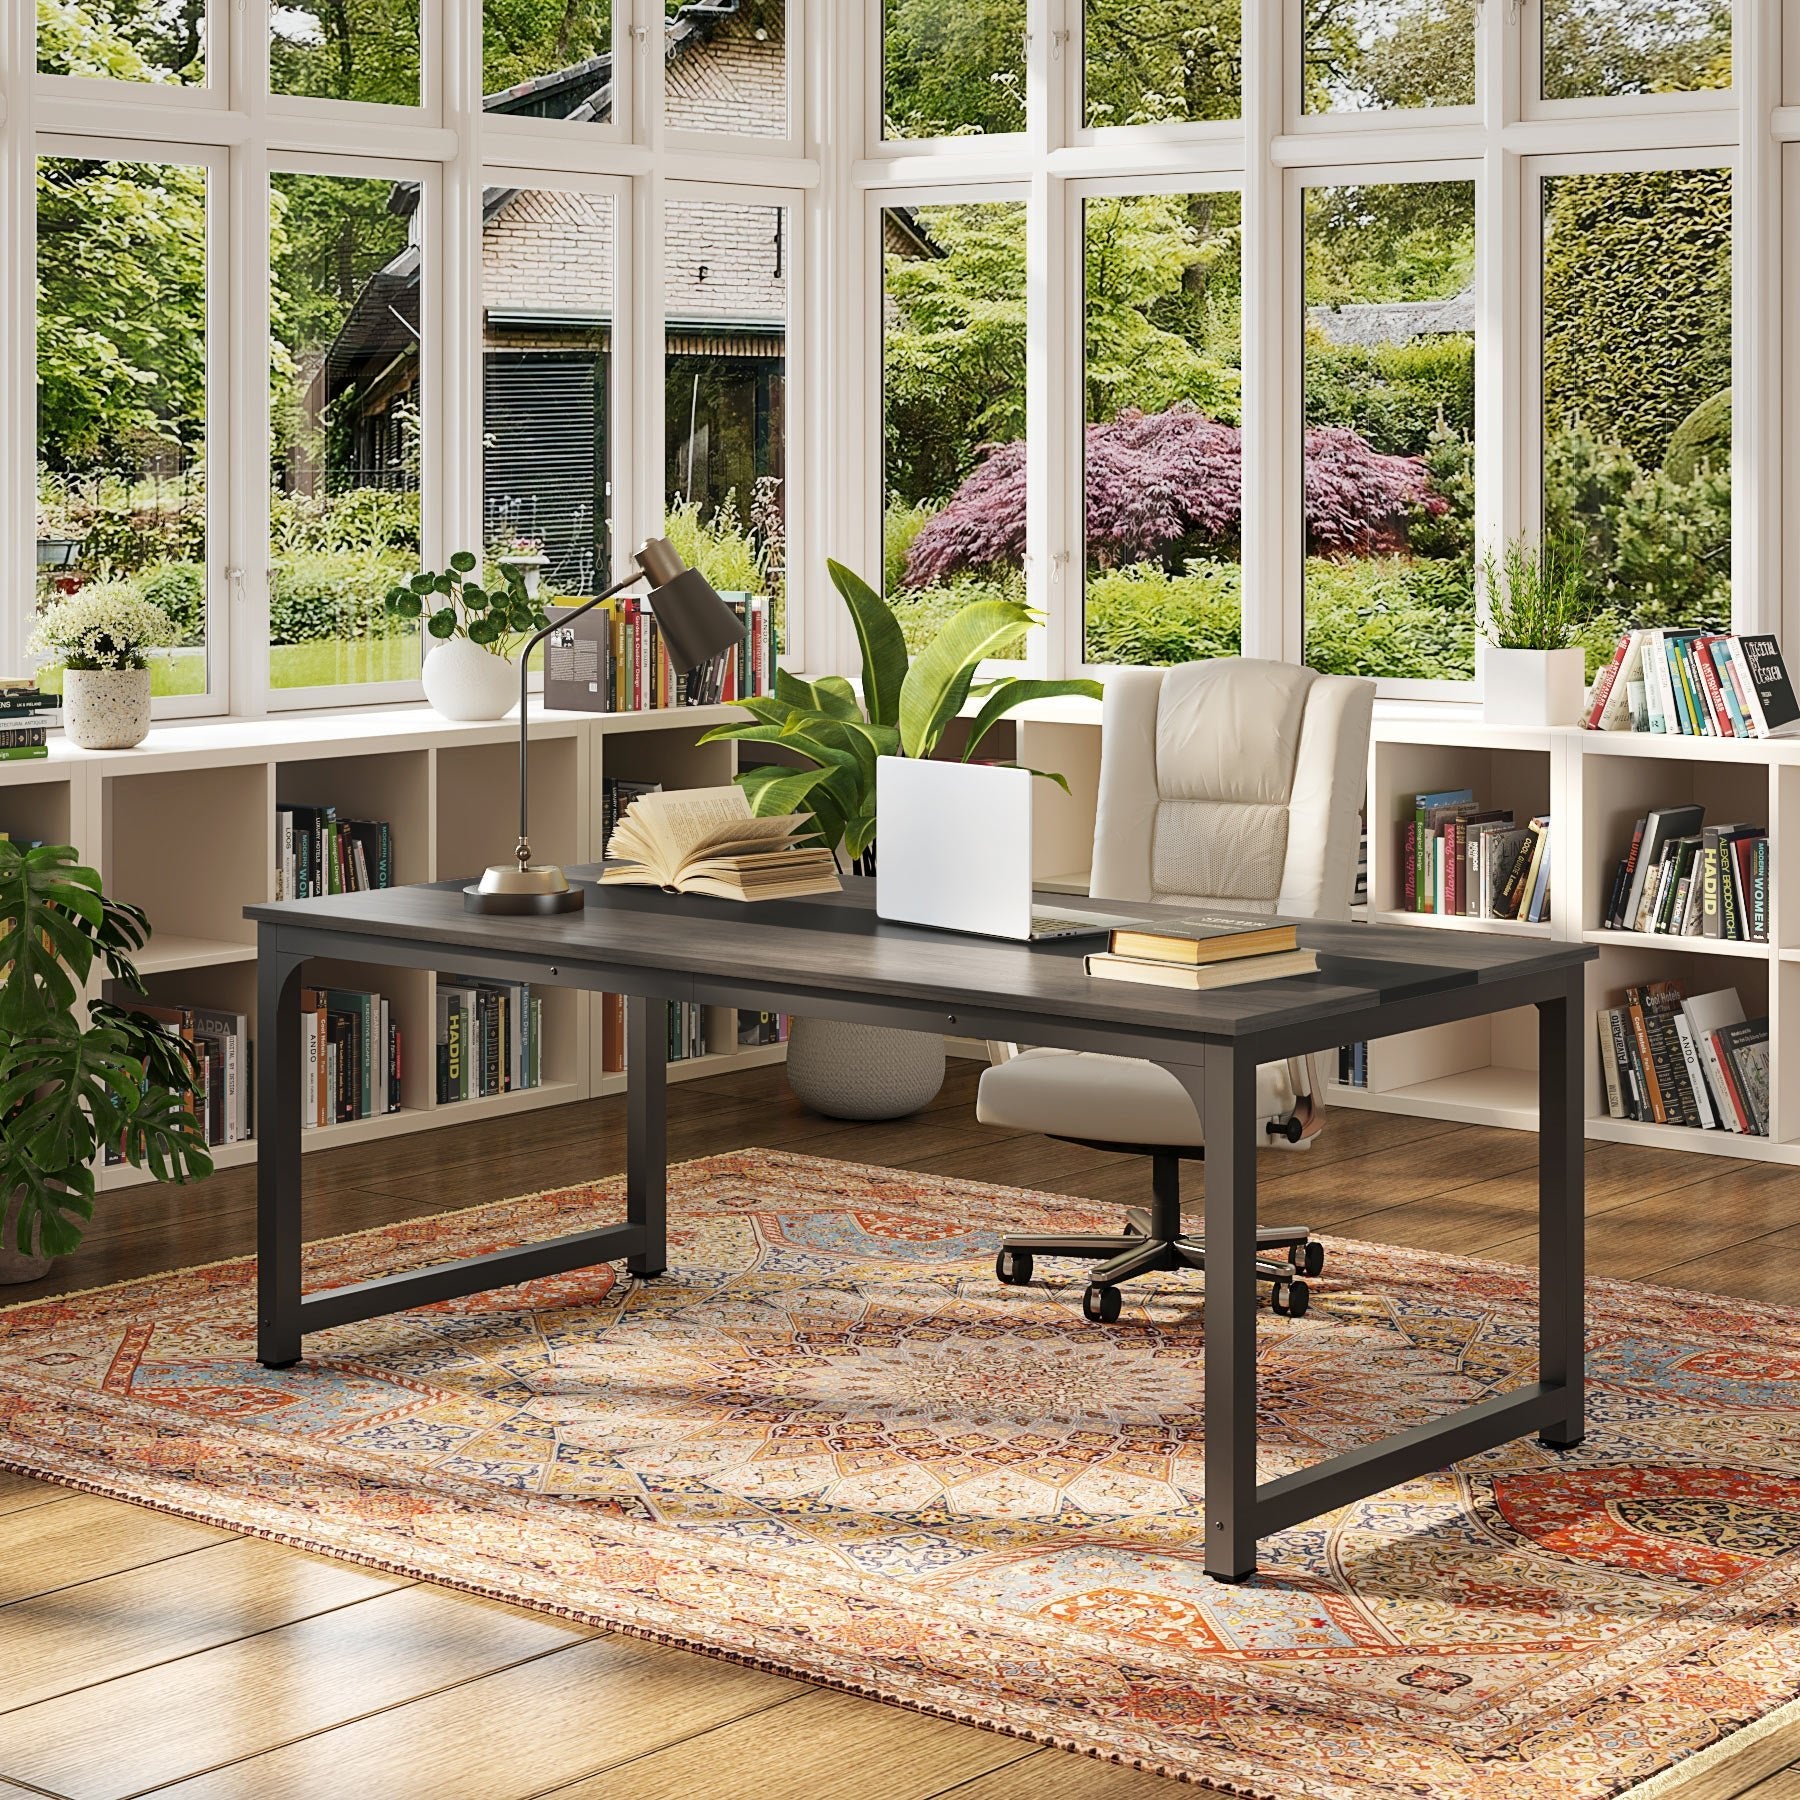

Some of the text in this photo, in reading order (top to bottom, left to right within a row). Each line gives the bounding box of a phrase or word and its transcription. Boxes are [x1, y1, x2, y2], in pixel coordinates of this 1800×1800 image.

[1405, 824, 1415, 898] Martin Parr
[1445, 826, 1455, 902] Martin Parr
[1503, 873, 1516, 897] London
[1514, 856, 1525, 876] GUIDE
[1704, 848, 1718, 915] HADID
[1719, 837, 1737, 934] ALEXEY BRODOVITCH
[1754, 878, 1764, 932] WOMEN
[1646, 996, 1660, 1007] Cool
[449, 1014, 459, 1079] HADID
[1634, 1017, 1642, 1033] Cool
[1638, 1034, 1647, 1055] Hotels
[1681, 1036, 1695, 1064] ANDO
